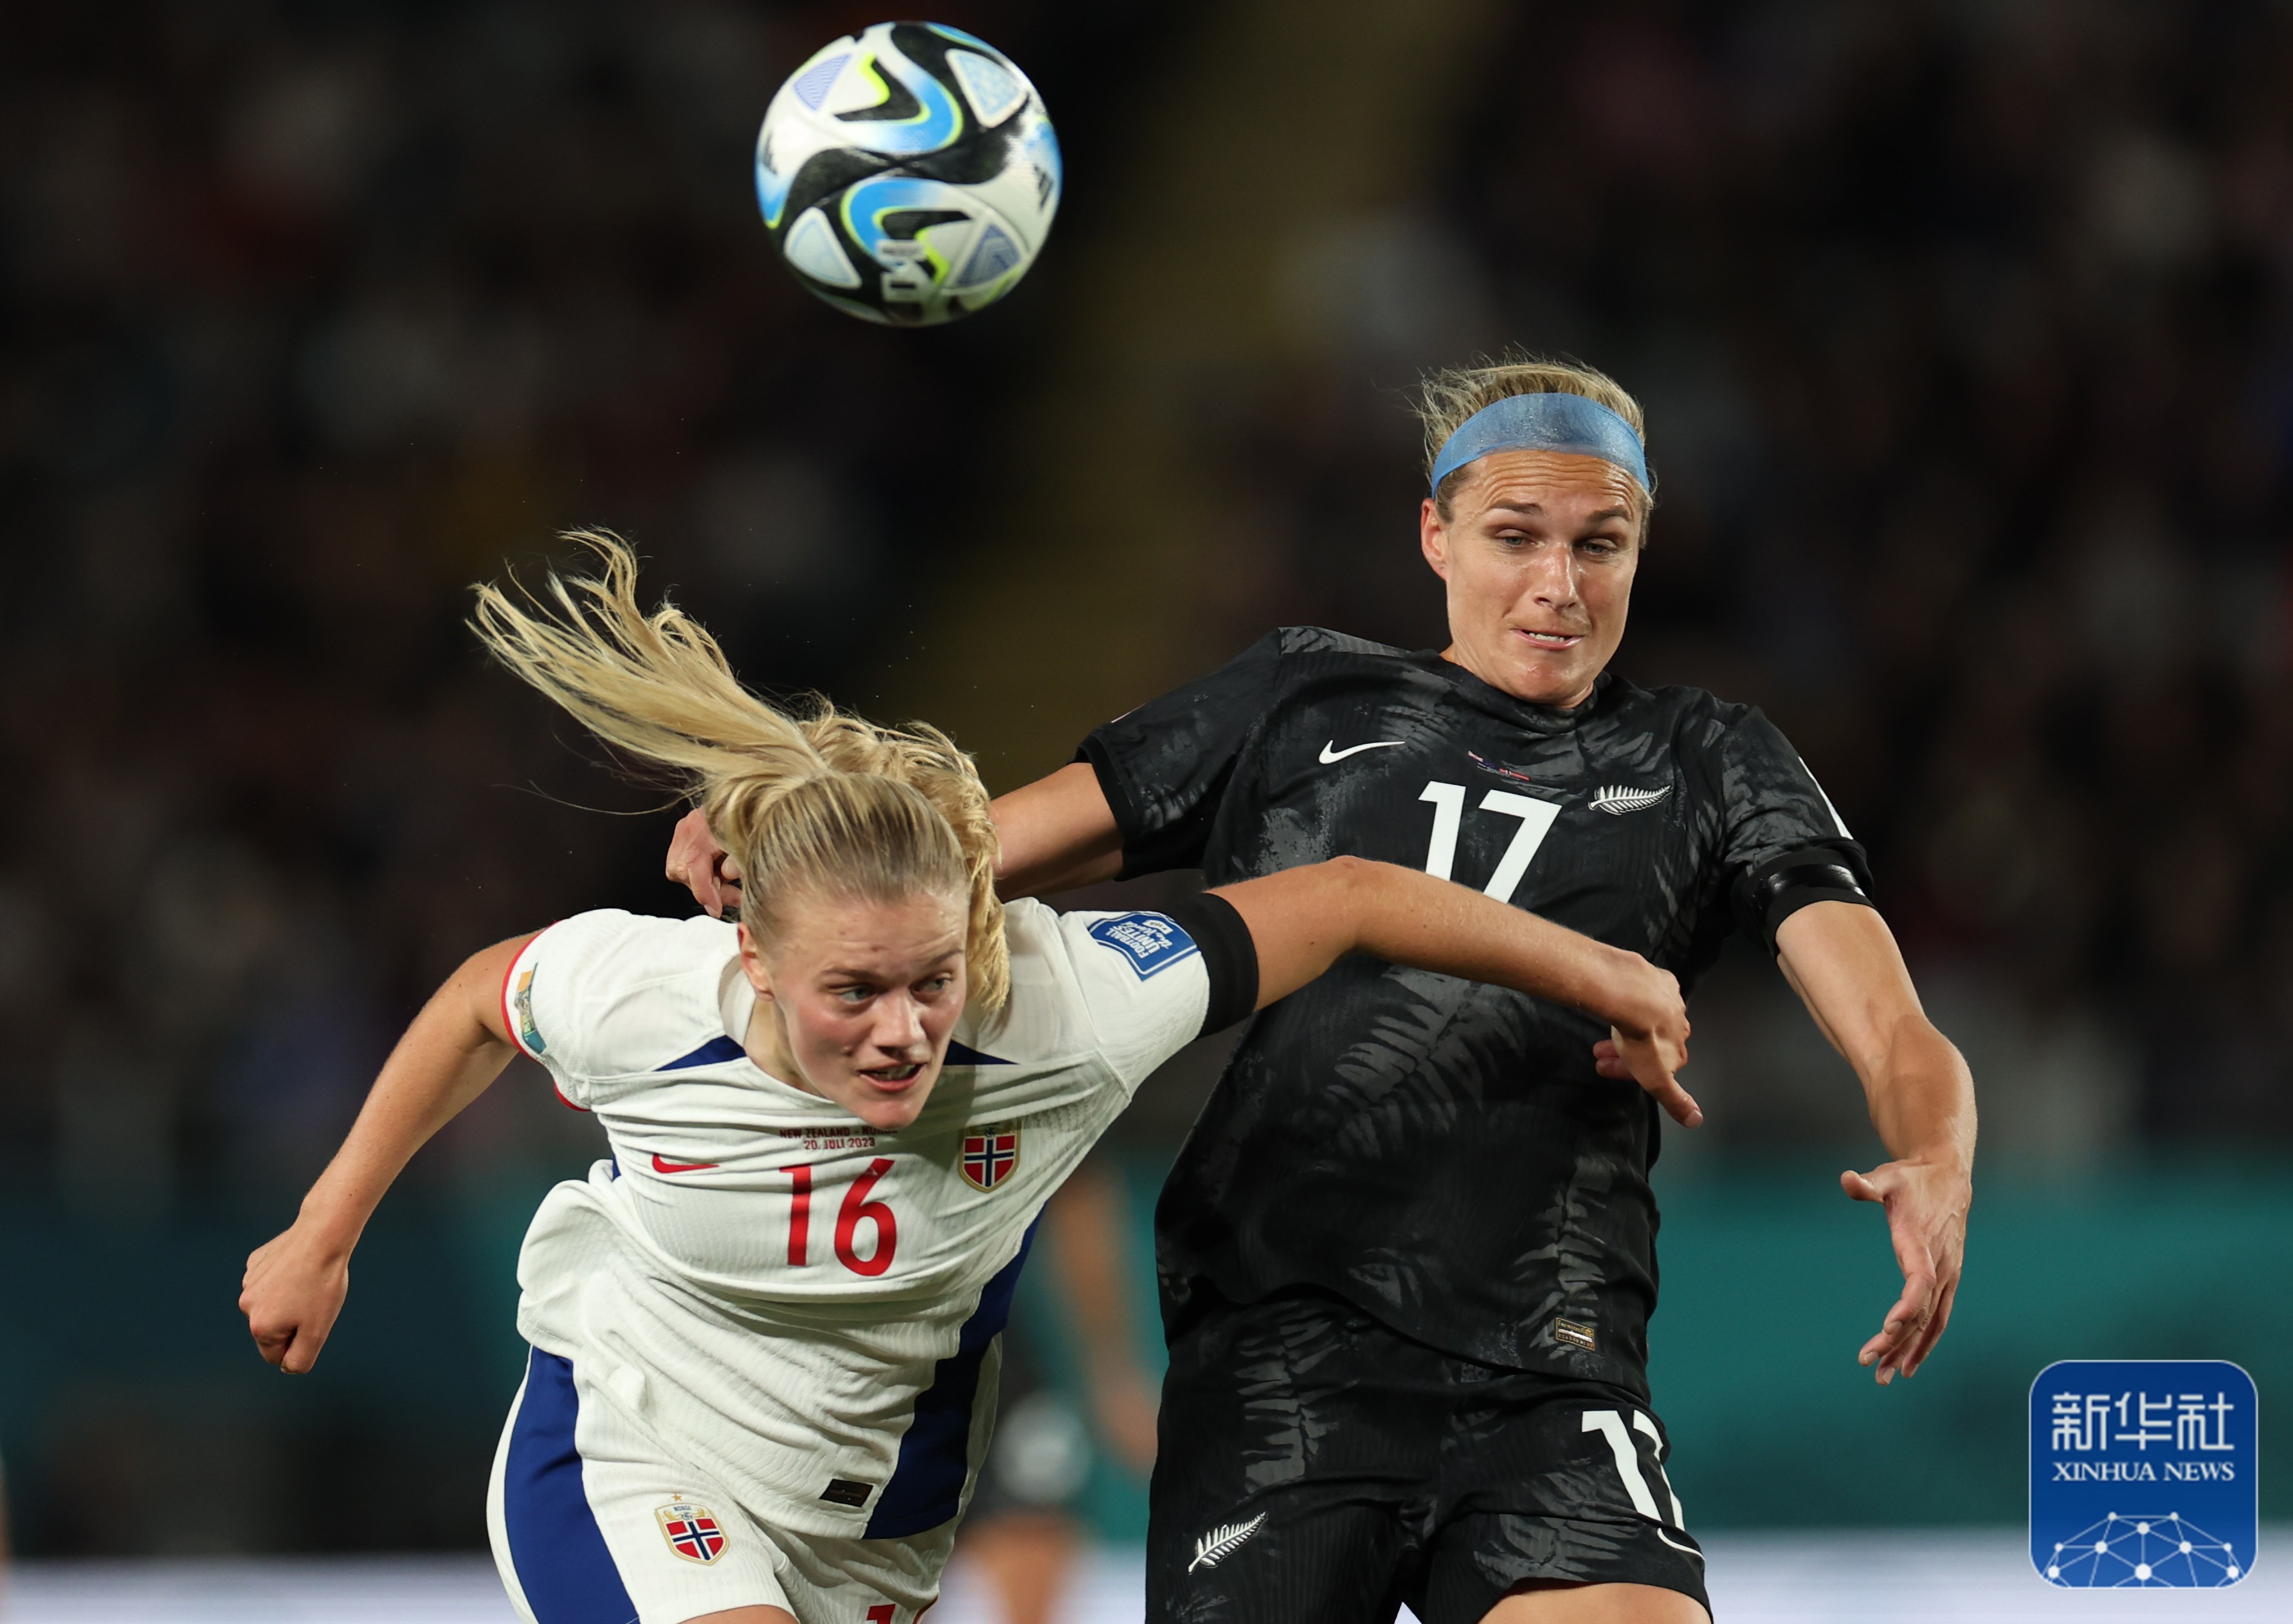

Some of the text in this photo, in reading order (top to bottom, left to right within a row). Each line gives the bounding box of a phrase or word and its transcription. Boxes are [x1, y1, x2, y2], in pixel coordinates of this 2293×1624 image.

[1418, 780, 1563, 903] 17
[1105, 927, 1150, 959] FOOTBALL
[1112, 925, 1160, 953] UNITES
[779, 1128, 802, 1139] NEW
[805, 1127, 851, 1138] ZEALAND
[804, 1137, 876, 1150] 20. JULI 2023
[779, 1158, 897, 1276] 16
